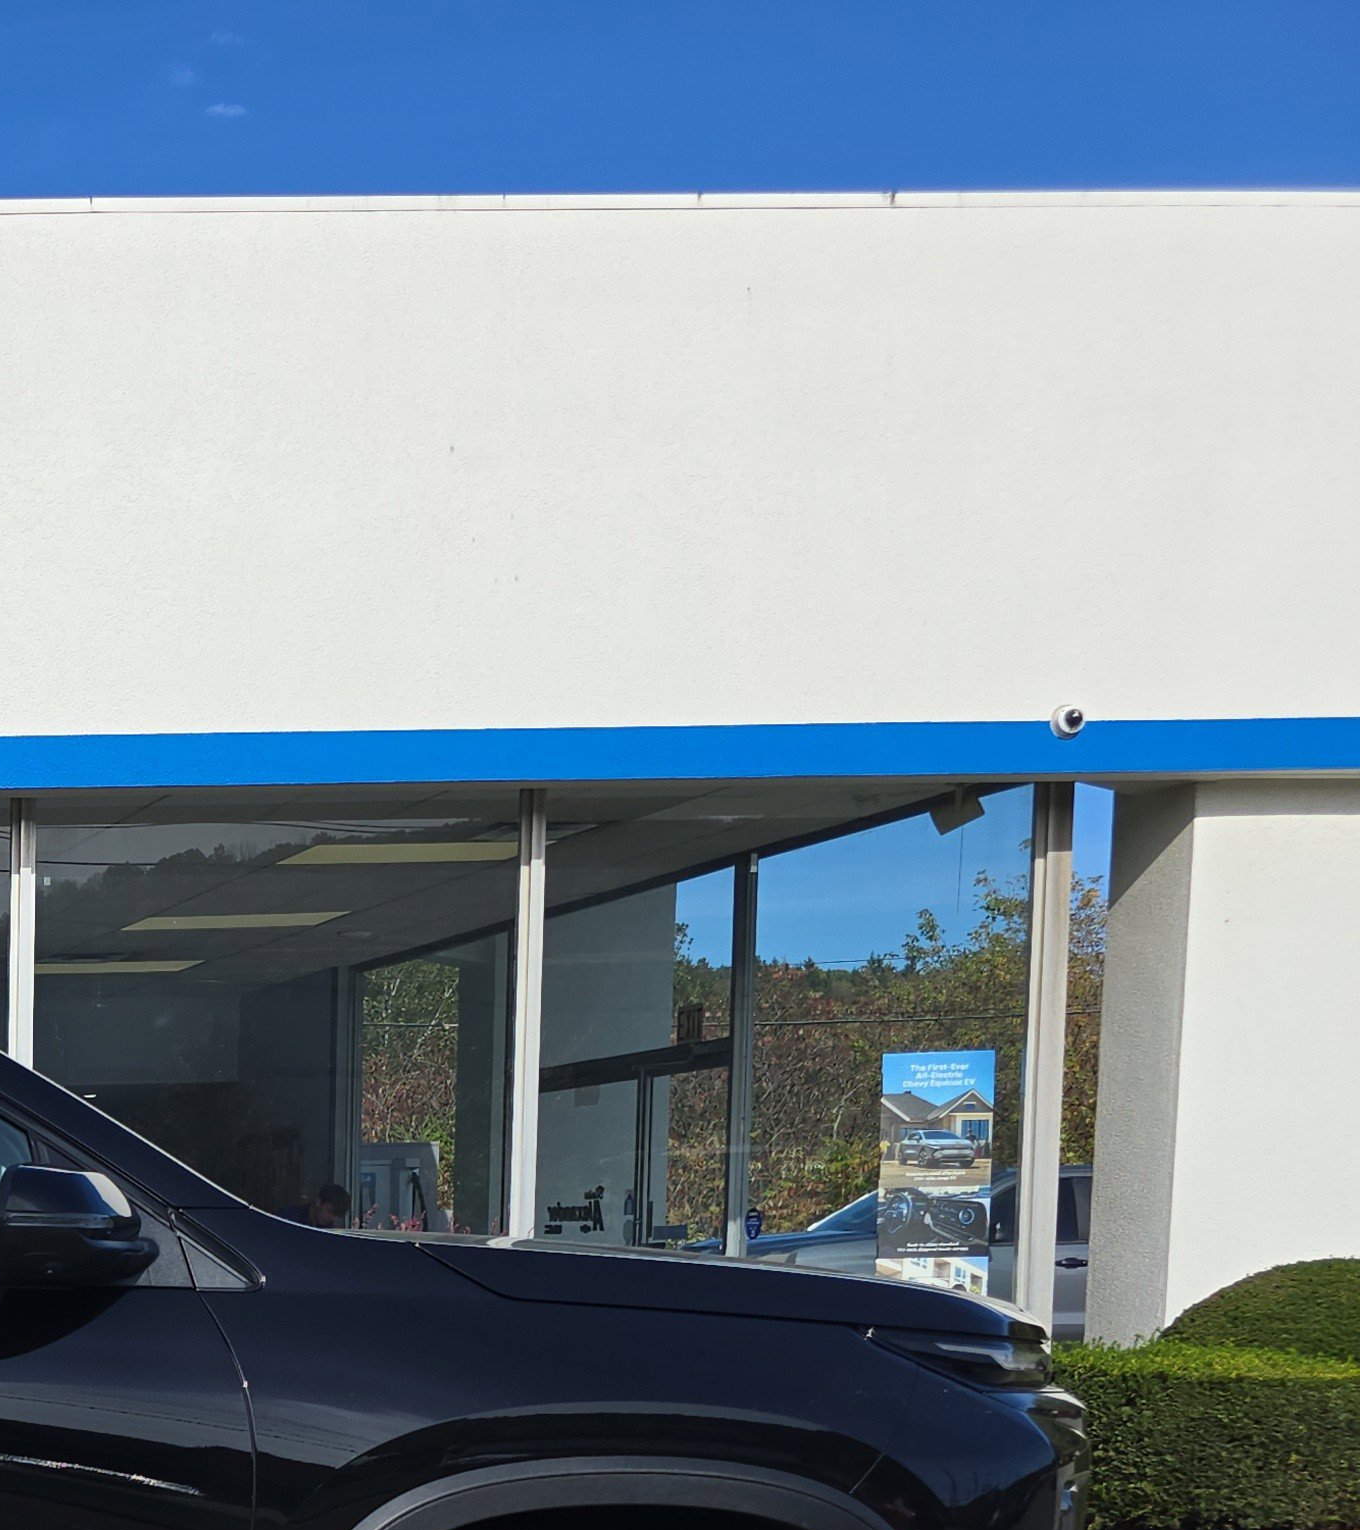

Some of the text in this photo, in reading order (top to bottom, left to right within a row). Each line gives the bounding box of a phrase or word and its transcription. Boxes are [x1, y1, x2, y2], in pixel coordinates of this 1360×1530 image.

[909, 1062, 970, 1072] The First-Ever
[902, 1077, 976, 1089] Chevy Equinox EV
